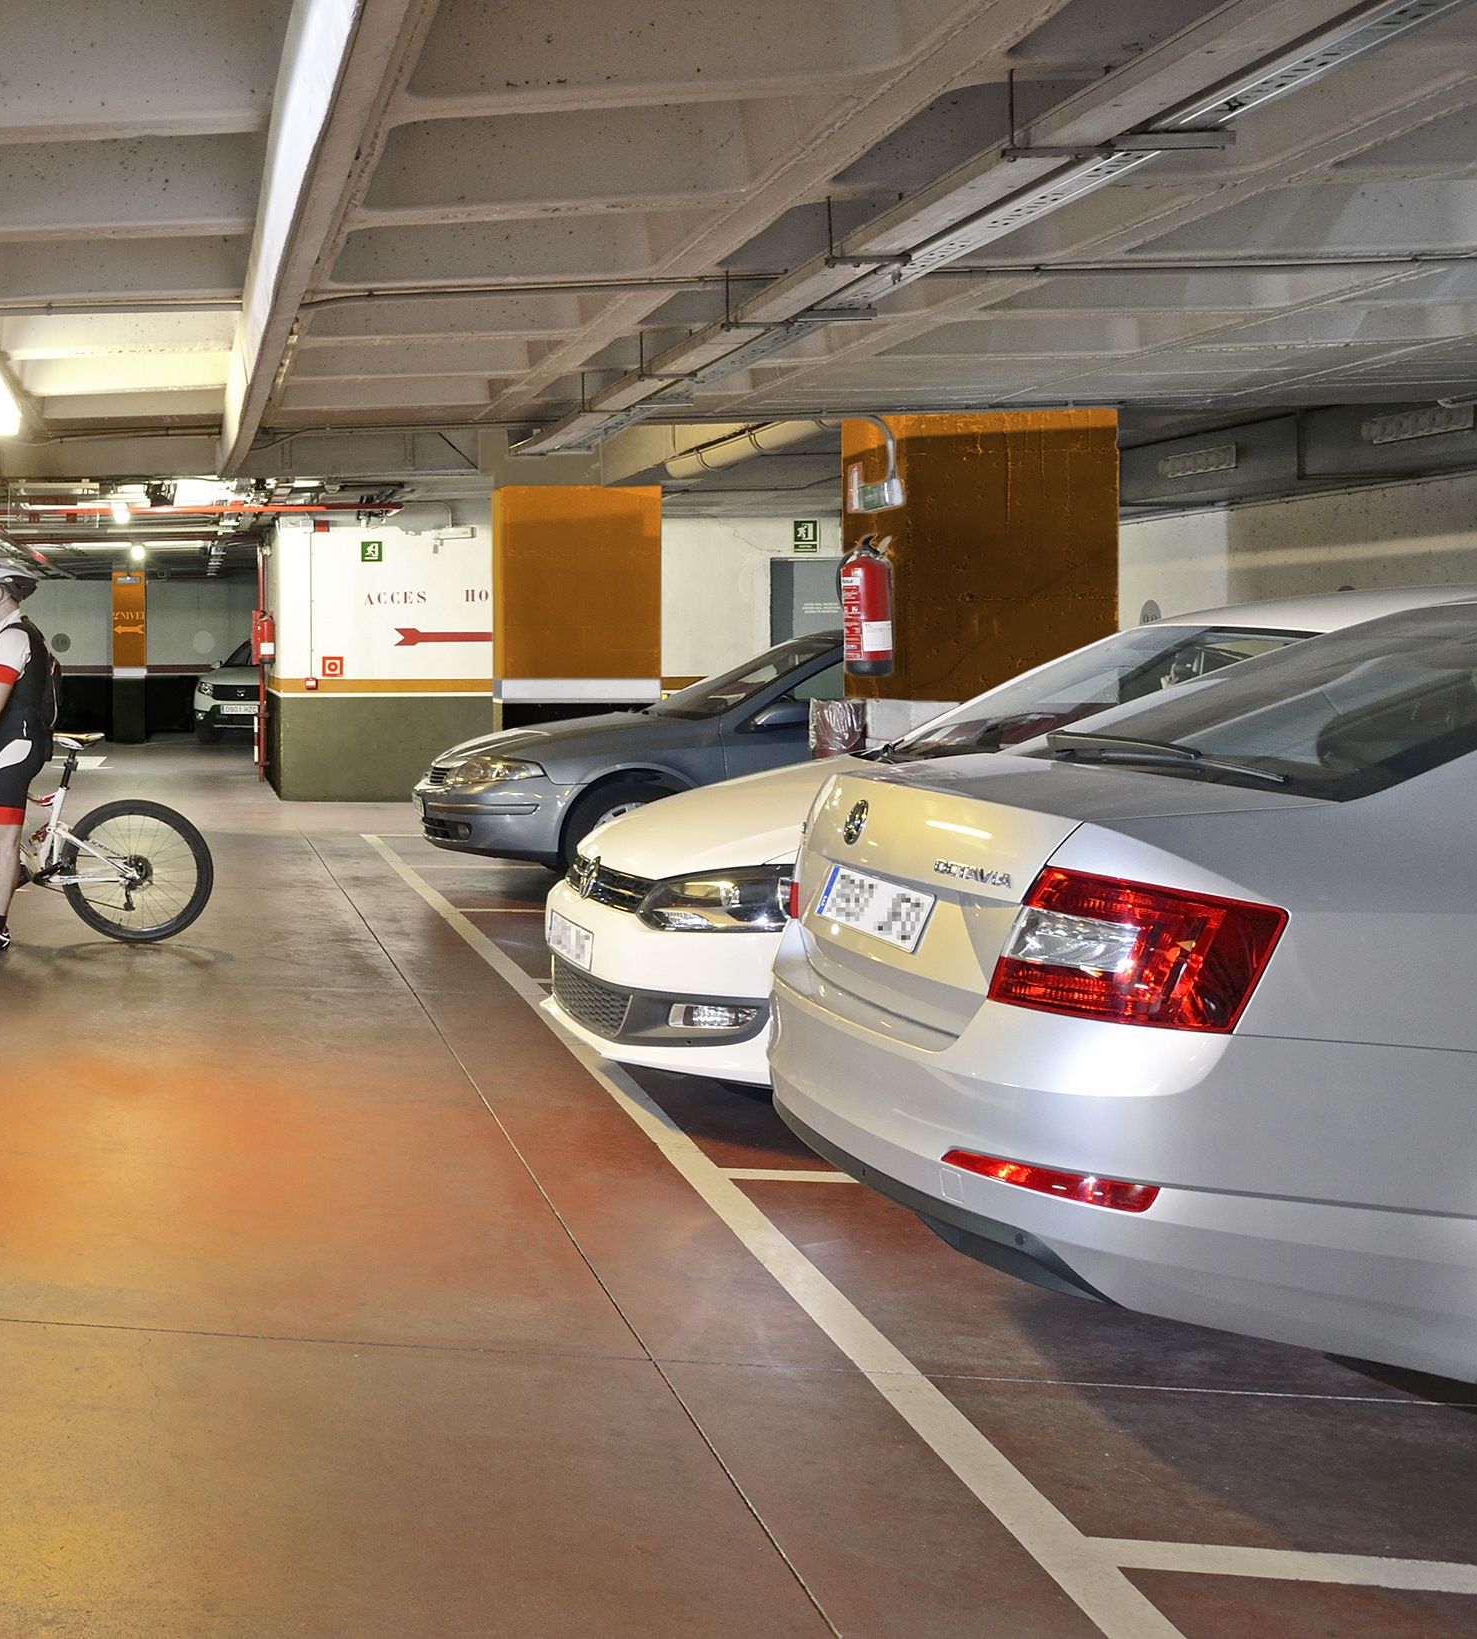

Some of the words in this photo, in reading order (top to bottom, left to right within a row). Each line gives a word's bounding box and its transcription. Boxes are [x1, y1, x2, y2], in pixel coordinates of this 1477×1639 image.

[364, 591, 427, 605] ACCES
[465, 589, 489, 602] HO
[934, 860, 1011, 888] OCTAVIA
